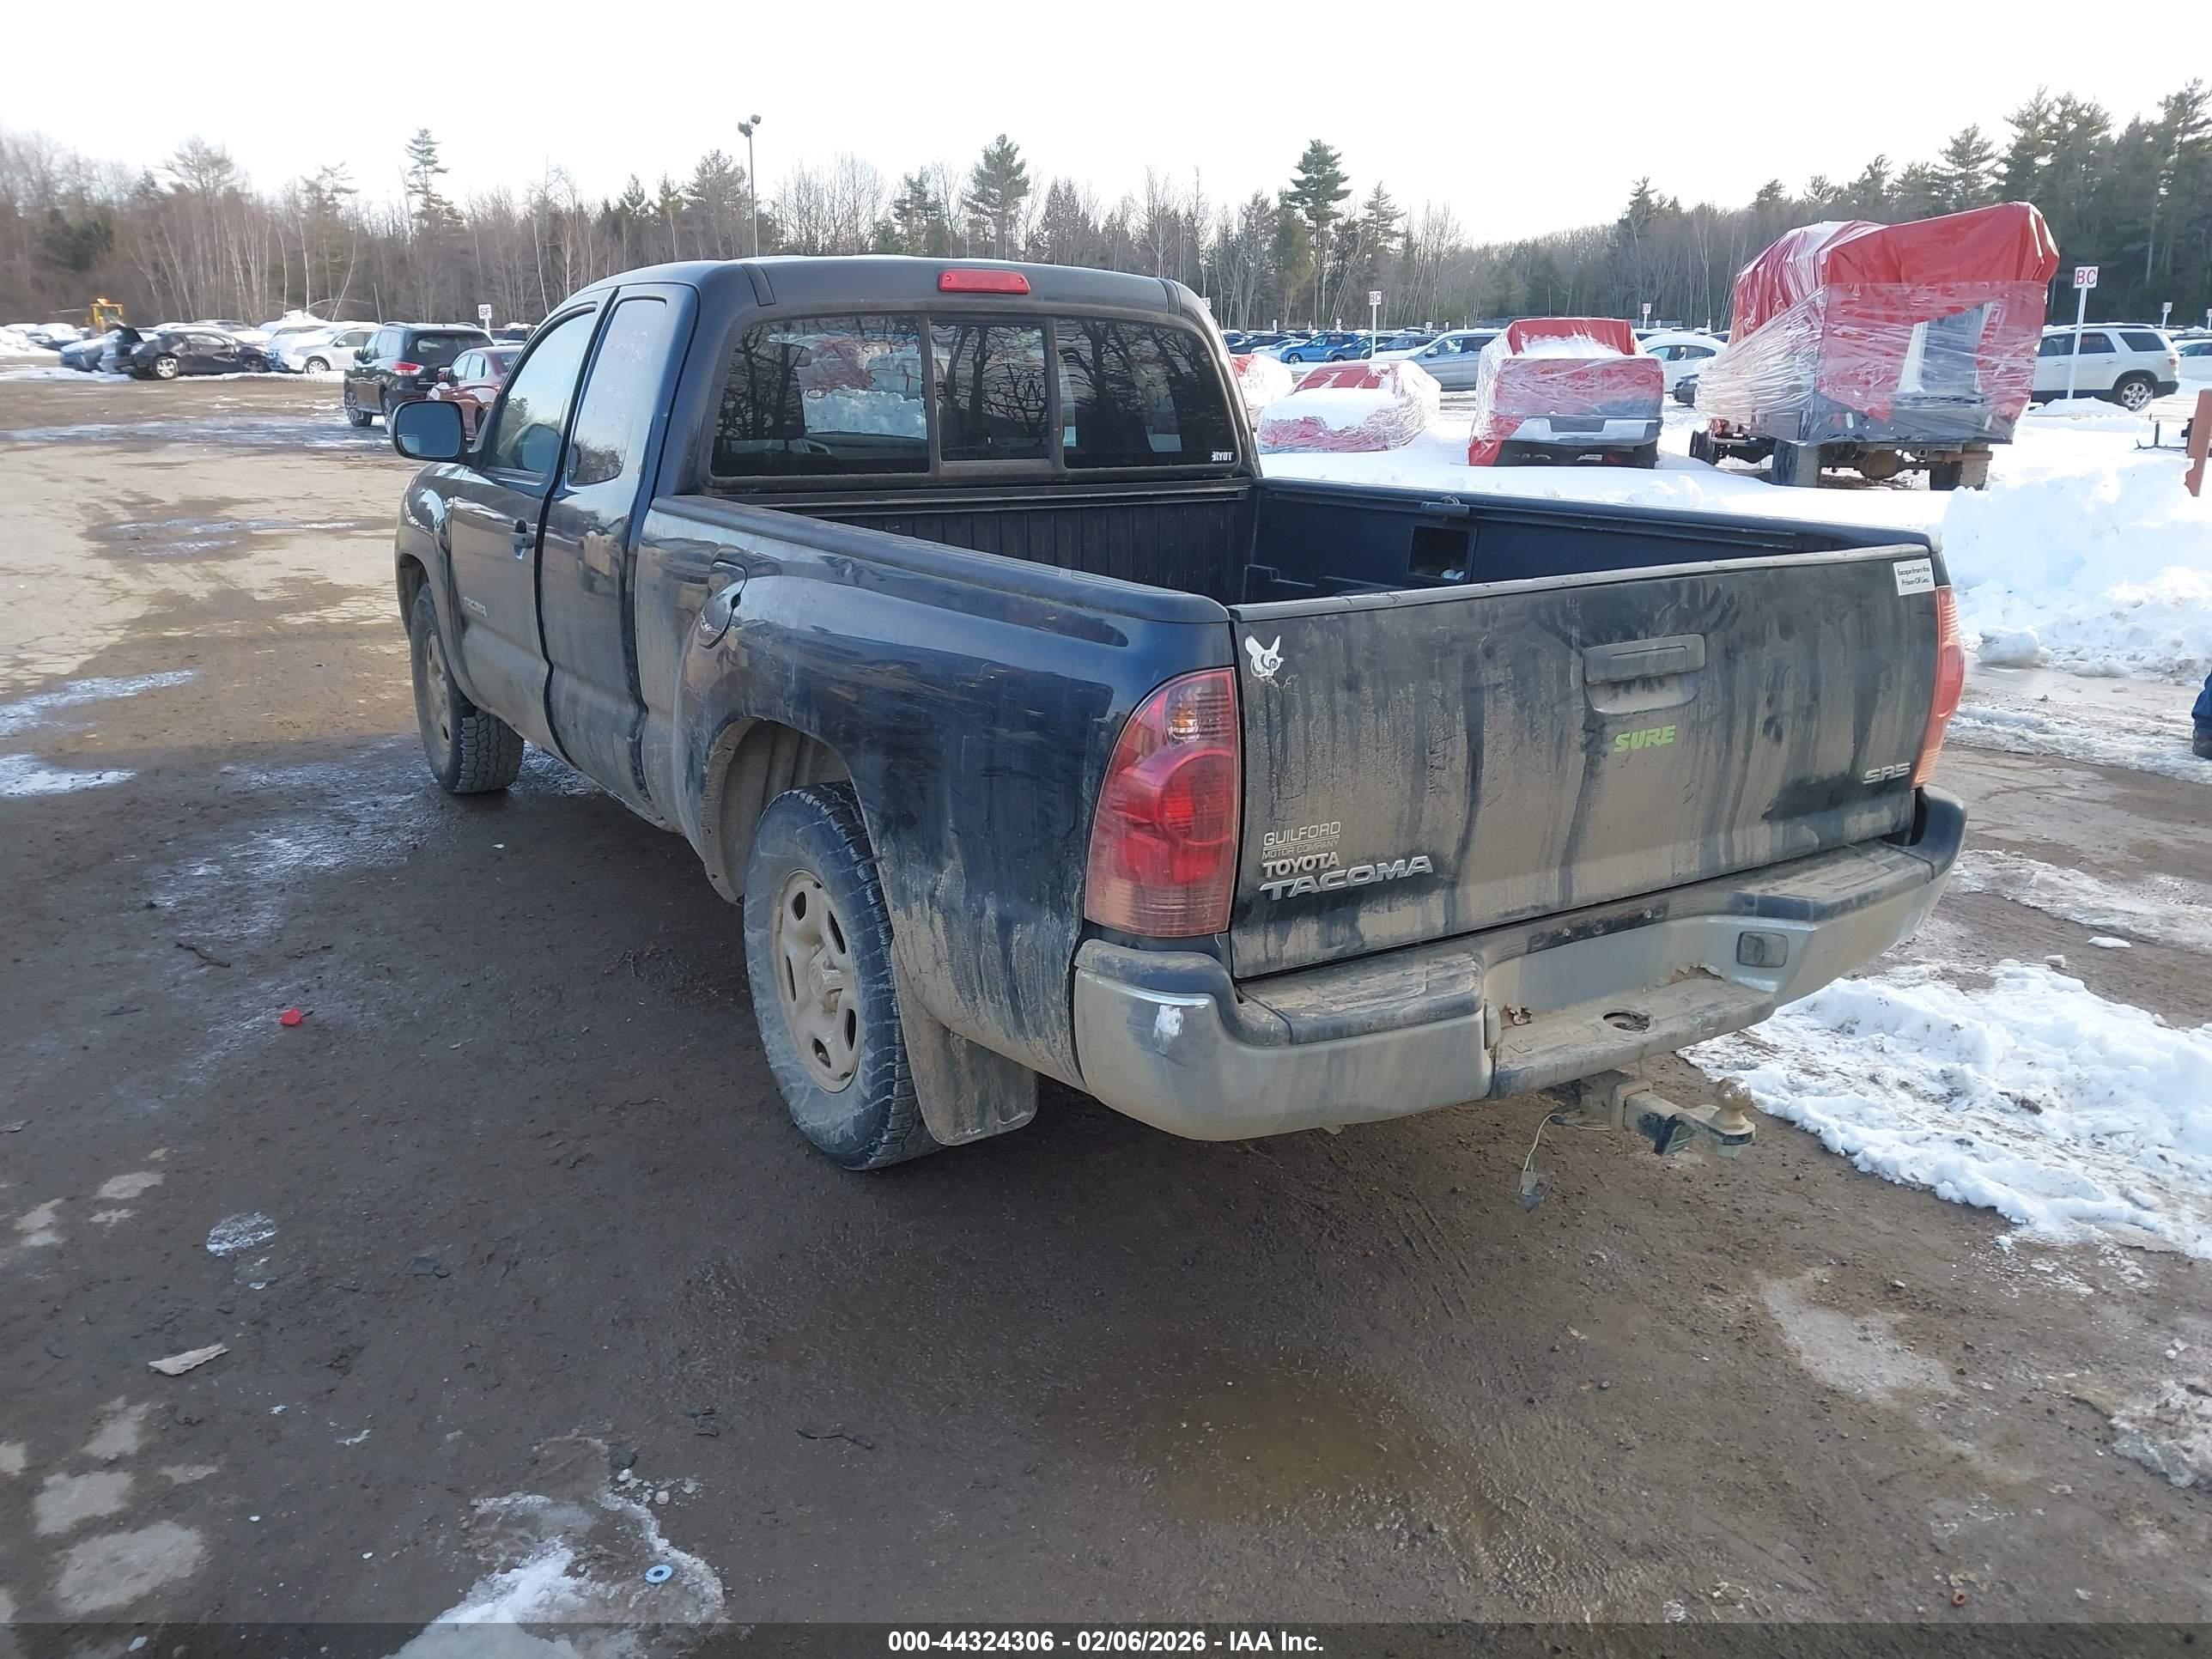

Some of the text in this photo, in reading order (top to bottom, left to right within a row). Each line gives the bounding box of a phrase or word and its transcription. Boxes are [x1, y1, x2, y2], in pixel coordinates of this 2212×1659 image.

[2076, 269, 2096, 285] BC
[1370, 293, 1381, 303] BC
[479, 307, 490, 316] SF
[1614, 725, 1676, 754] SURE
[1862, 763, 1911, 785] SR5
[1263, 821, 1341, 847] GUILFORD
[1262, 839, 1340, 860] MOTOR COMPANY
[1262, 852, 1340, 878] TOYOTA
[1259, 855, 1434, 901] TACOMA
